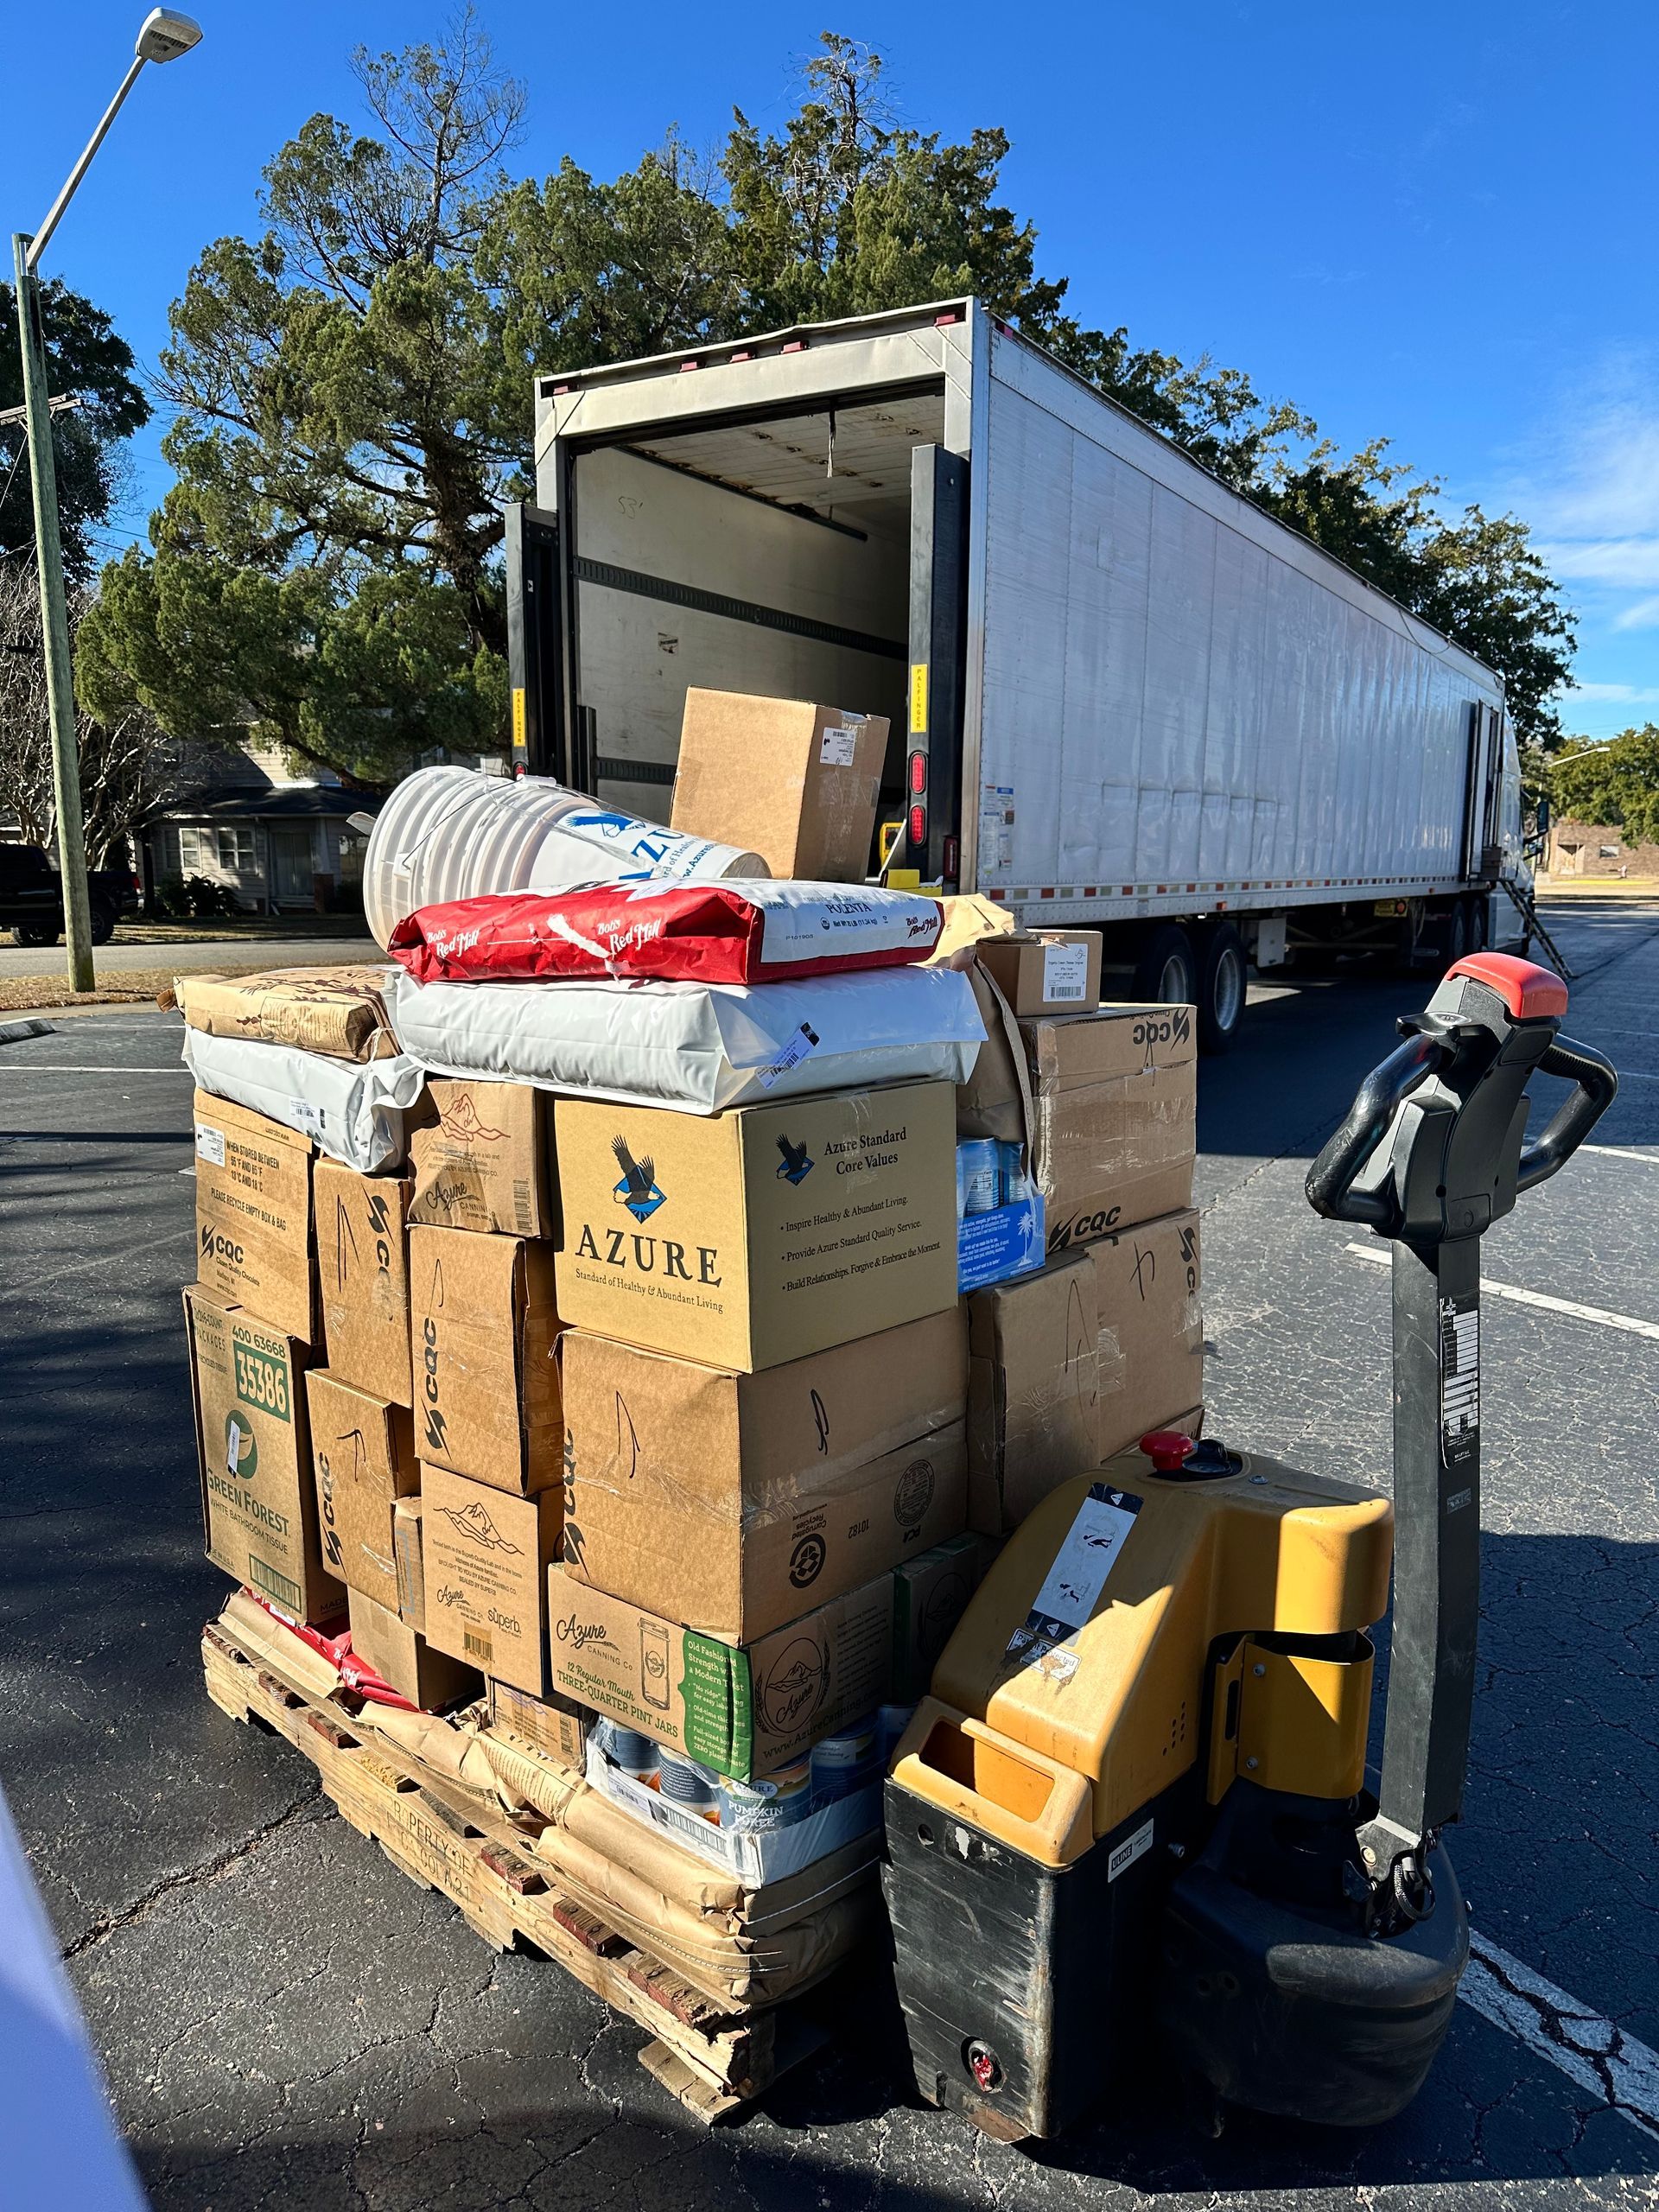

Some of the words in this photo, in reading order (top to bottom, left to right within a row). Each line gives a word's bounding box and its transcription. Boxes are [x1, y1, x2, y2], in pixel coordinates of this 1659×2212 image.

[824, 902, 872, 914] POLENTA
[427, 929, 447, 944] Bob's
[597, 918, 620, 937] Bob's
[609, 932, 634, 956] Red
[634, 918, 662, 950] Mill
[907, 923, 925, 939] Red
[435, 940, 457, 959] Red
[457, 928, 480, 957] Mill
[1133, 1021, 1171, 1046] CQC
[823, 1141, 858, 1156] Azure
[859, 1127, 907, 1149] Standard
[226, 1140, 239, 1154] WHEN
[240, 1145, 257, 1161] STORED
[257, 1152, 280, 1170] BETWEEN
[242, 1160, 251, 1173] AND
[836, 1160, 863, 1176] Core
[864, 1153, 899, 1169] Values
[242, 1174, 251, 1187] AND
[425, 1180, 467, 1212] Azure
[460, 1201, 488, 1213] CANNIN
[211, 1187, 226, 1204] PLEASE
[226, 1194, 245, 1213] RECYCLE
[245, 1203, 260, 1219] EMPTY
[262, 1211, 271, 1224] BOX
[276, 1216, 287, 1231] BAG
[785, 1219, 812, 1233] Inspire
[813, 1211, 842, 1226] Healthy
[843, 1209, 850, 1218] &
[851, 1199, 885, 1217] Abundant
[885, 1196, 909, 1209] Living.
[1074, 1205, 1122, 1237] CQC
[216, 1235, 244, 1264] CQC
[786, 1245, 816, 1262] Provide
[817, 1242, 839, 1255] Azure
[840, 1231, 870, 1249] Standard
[871, 1225, 897, 1241] Quality
[897, 1219, 923, 1234] Service.
[575, 1224, 722, 1288] AZURE
[786, 1277, 806, 1293] Build
[850, 1259, 874, 1274] Forgive
[874, 1258, 881, 1268] &
[881, 1252, 908, 1266] Embrace
[907, 1247, 917, 1257] the
[575, 1268, 607, 1285] Standard
[607, 1277, 617, 1286] of
[617, 1277, 646, 1297] Healthy
[647, 1285, 656, 1295] &
[656, 1287, 696, 1306] Abundant
[696, 1296, 724, 1315] Living
[232, 1325, 251, 1344] 400
[253, 1334, 286, 1359] 63668
[423, 1317, 437, 1404] CQC
[237, 1350, 287, 1414] 35386
[207, 1467, 243, 1509] GREEN
[244, 1491, 289, 1536] FOREST
[210, 1497, 229, 1516] WHITE
[229, 1508, 265, 1540] BATHROOM
[264, 1533, 289, 1555] TISSUE
[791, 1519, 827, 1541] Corrugated
[796, 1513, 824, 1530] Recycles
[438, 1559, 457, 1570] BROUGHT
[478, 1573, 491, 1585] AZURE
[491, 1580, 510, 1592] CANNING
[459, 1575, 474, 1587] SEALED
[436, 1585, 464, 1607] Azure
[456, 1603, 476, 1615] CANNING
[556, 1614, 607, 1649] Azure
[587, 1645, 621, 1666] CANNING
[688, 1640, 701, 1652] Old
[701, 1647, 737, 1668] Fashiond
[688, 1653, 721, 1674] Strength
[567, 1661, 575, 1672] 12
[575, 1665, 606, 1689] Regular
[607, 1680, 636, 1702] Mouth
[694, 1668, 725, 1686] Modern
[724, 1679, 745, 1693] Tist
[556, 1669, 629, 1714] THREE-QUARTER
[630, 1705, 653, 1726] PINT
[654, 1717, 679, 1738] JARS
[693, 1692, 702, 1701] for
[702, 1694, 715, 1707] easy
[693, 1704, 717, 1719] Old-time
[775, 1682, 814, 1725] Azure
[693, 1714, 704, 1723] and
[704, 1717, 729, 1733] strength
[693, 1726, 720, 1742] Full-sized
[693, 1735, 707, 1745] easy
[707, 1739, 728, 1754] storage
[693, 1743, 709, 1754] ZERO
[709, 1749, 728, 1763] plastic
[728, 1799, 785, 1817] PUMPKIN
[1112, 1846, 1133, 1869] ULINE
